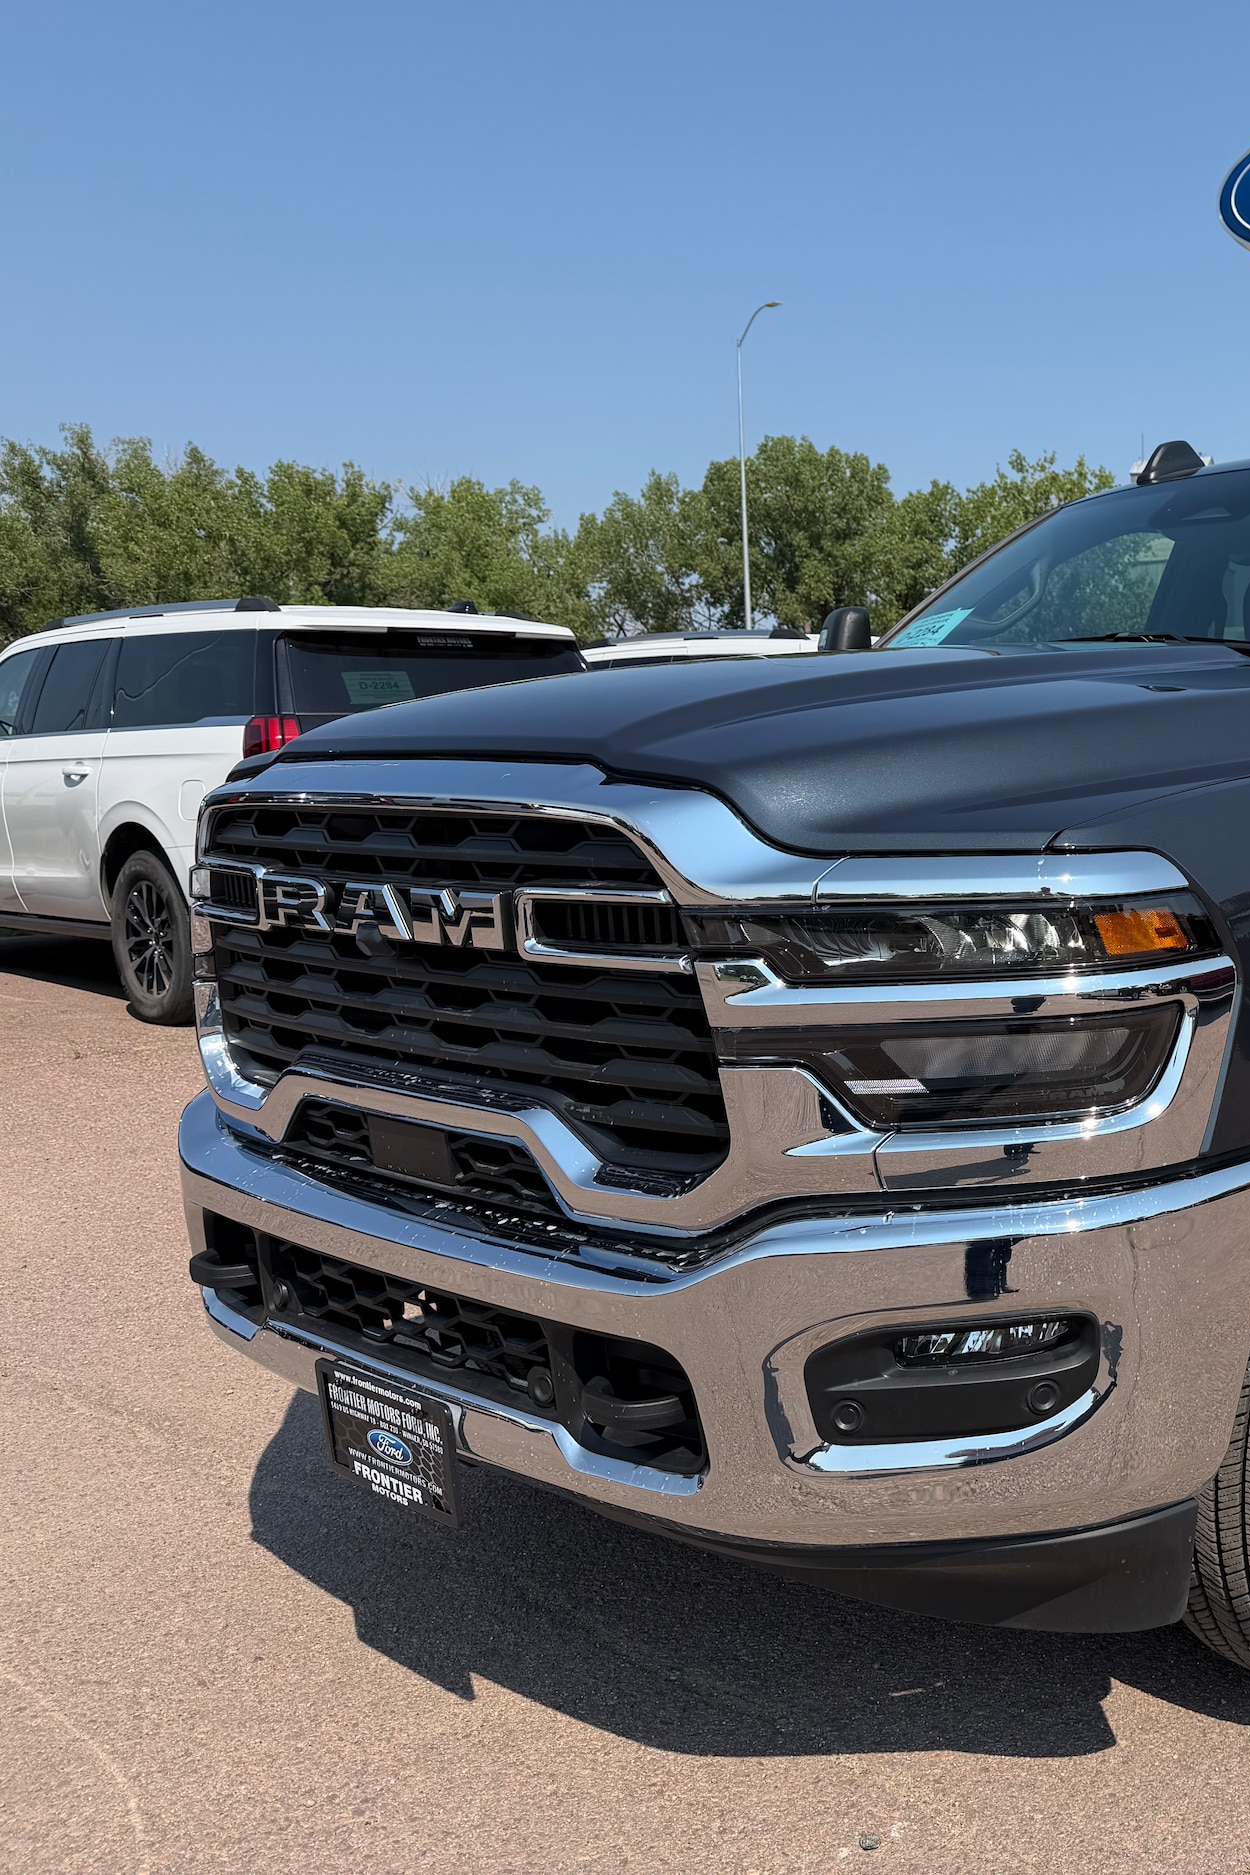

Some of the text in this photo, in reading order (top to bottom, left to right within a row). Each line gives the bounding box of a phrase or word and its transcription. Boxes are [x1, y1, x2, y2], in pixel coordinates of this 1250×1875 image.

[358, 681, 400, 690] D-2284
[260, 873, 508, 950] RAM
[328, 1383, 367, 1412] FRONTIER
[366, 1398, 401, 1426] MOTORS
[333, 1370, 422, 1410] www.frontiermotors.com
[376, 1434, 405, 1461] Ford
[353, 1460, 424, 1505] FRONTIER
[371, 1483, 409, 1507] MOTORS
